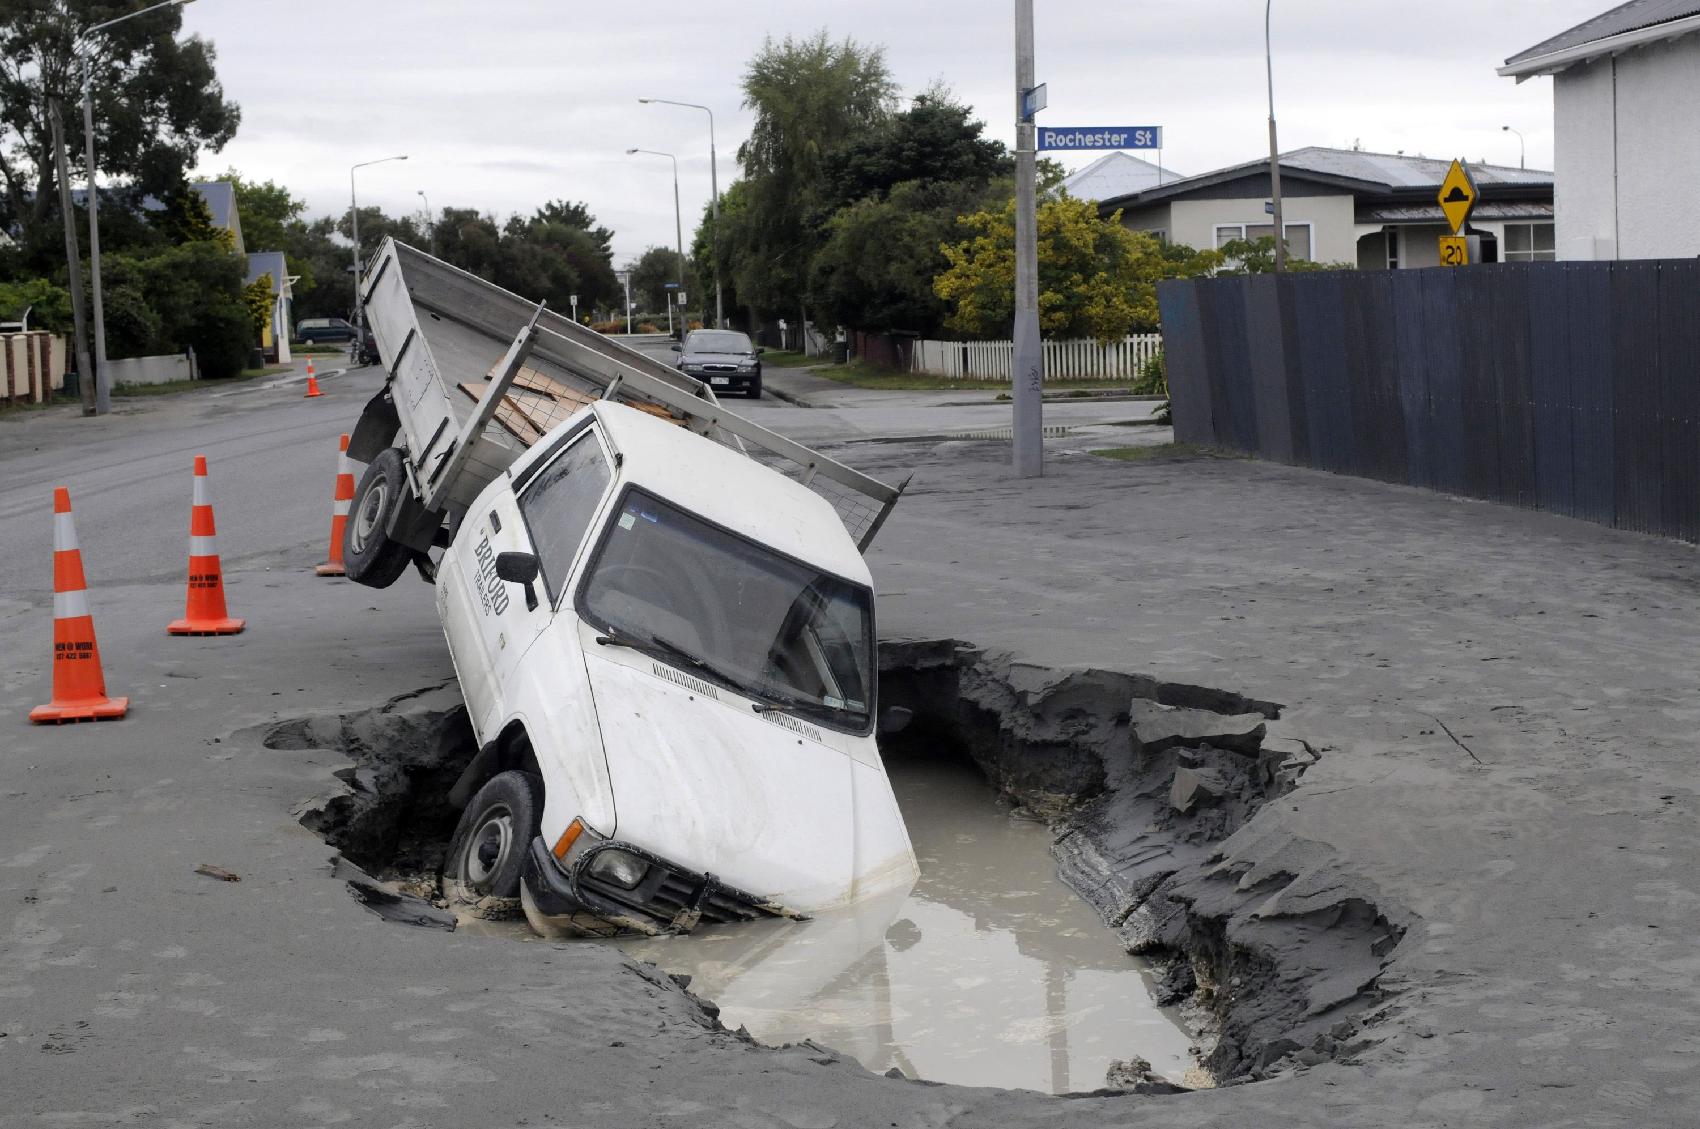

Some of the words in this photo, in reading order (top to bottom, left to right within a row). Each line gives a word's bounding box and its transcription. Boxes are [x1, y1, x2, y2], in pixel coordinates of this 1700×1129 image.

[1044, 131, 1128, 147] Rochester
[1135, 130, 1152, 146] St
[1446, 245, 1463, 265] 20
[474, 569, 491, 616] TRAILERS
[75, 642, 93, 650] WORK
